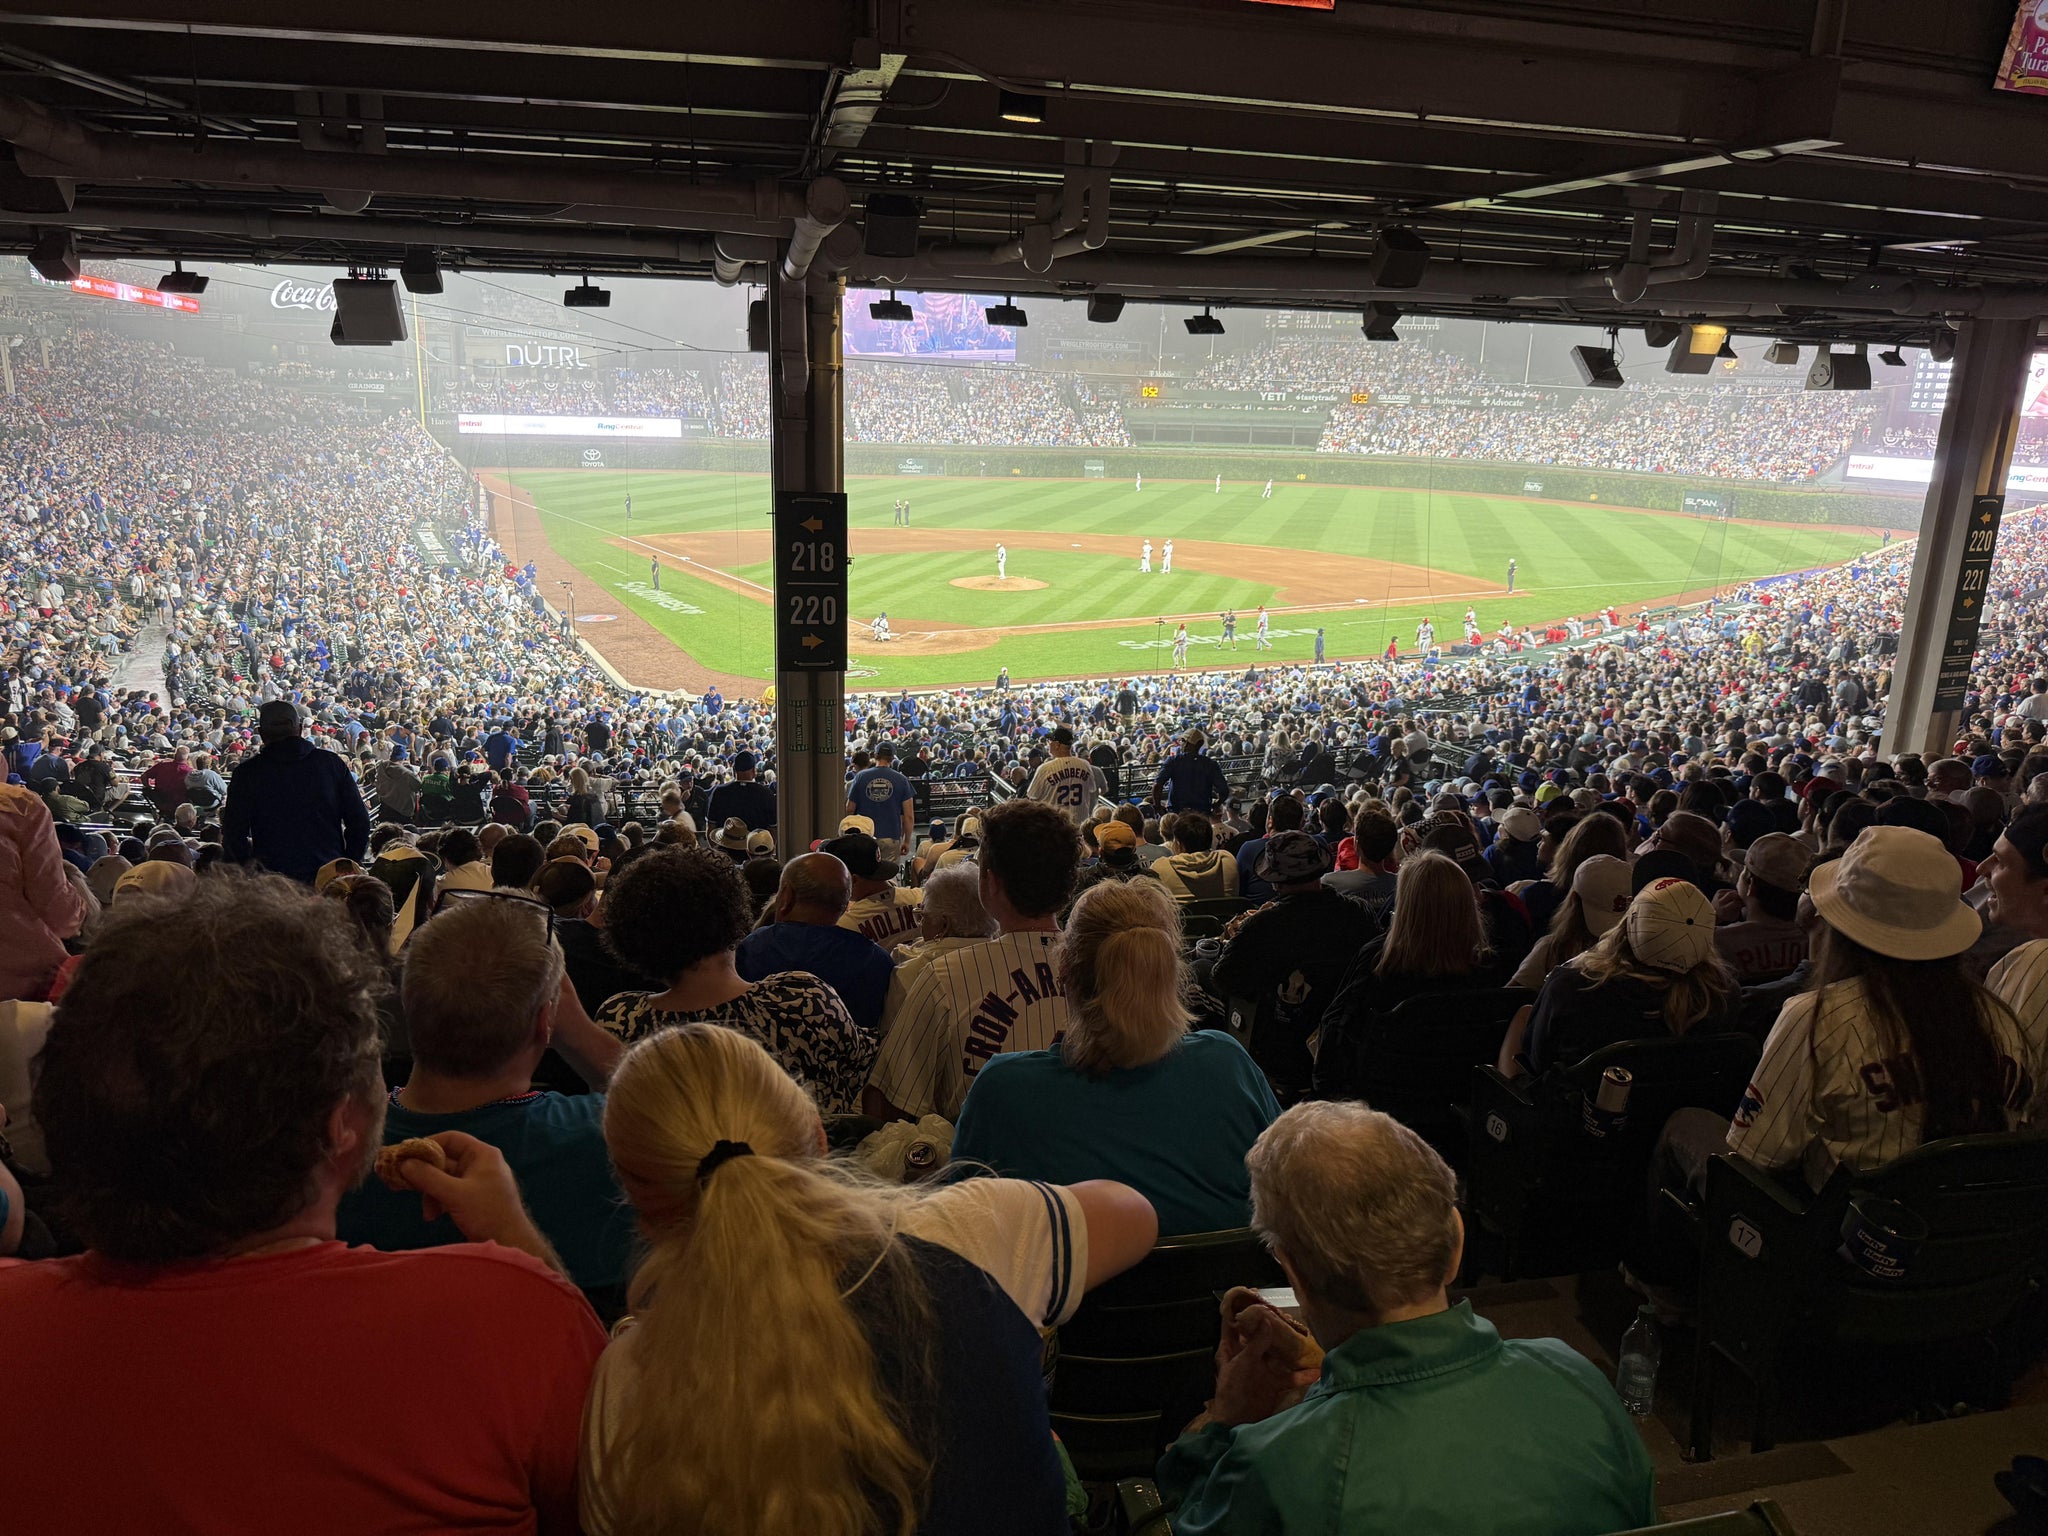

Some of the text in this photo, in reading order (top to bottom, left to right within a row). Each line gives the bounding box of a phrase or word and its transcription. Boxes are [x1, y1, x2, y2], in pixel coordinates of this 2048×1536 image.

[1260, 392, 1286, 401] YETI
[1433, 397, 1472, 406] Budweiser
[1491, 398, 1524, 407] Advocate
[2007, 473, 2048, 483] ingCent
[1968, 530, 1993, 552] 220
[791, 541, 834, 572] 218
[1962, 569, 1984, 591] 221
[790, 595, 837, 625] 220
[1057, 783, 1083, 807] 23
[858, 903, 921, 942] MOLIN
[962, 962, 1066, 1078] CROW-AR
[1492, 1119, 1503, 1136] 16
[1737, 1226, 1757, 1247] 17
